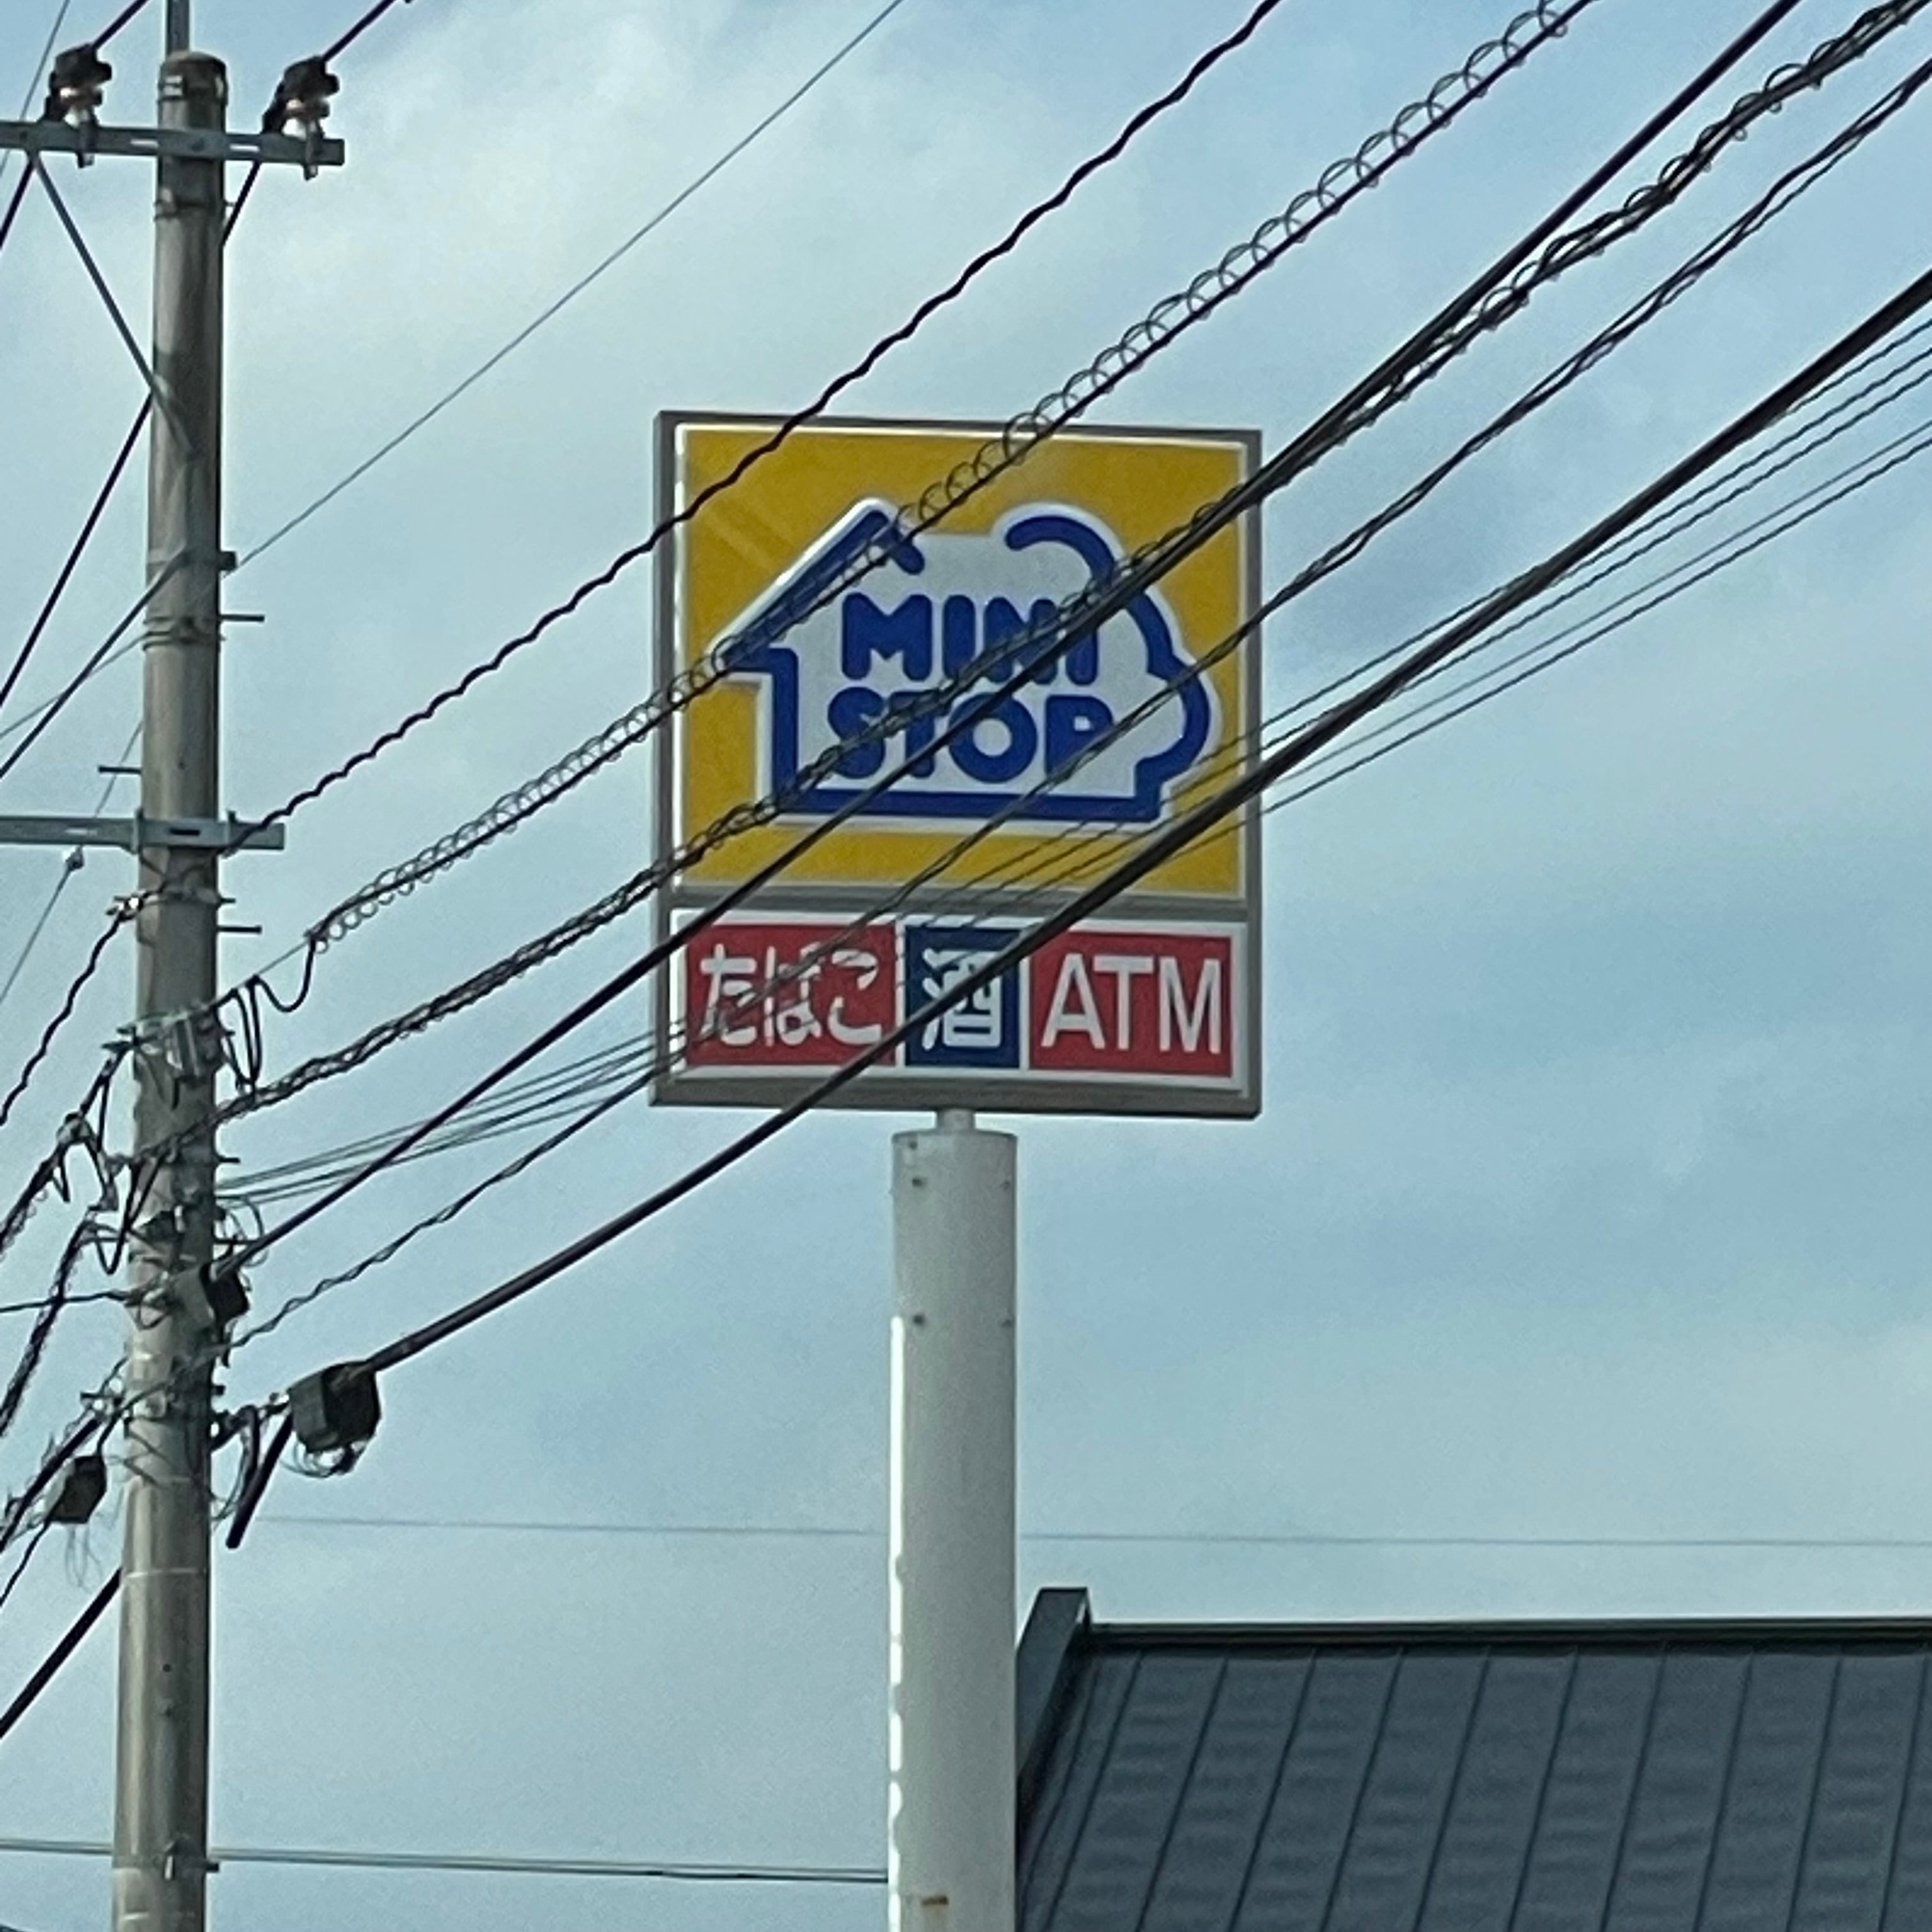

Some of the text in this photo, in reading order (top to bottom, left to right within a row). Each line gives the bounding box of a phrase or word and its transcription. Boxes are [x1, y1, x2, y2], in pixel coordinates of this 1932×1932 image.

[841, 592, 1098, 686] MINI
[827, 686, 1114, 784] STOP
[700, 941, 882, 1047] たばこ
[921, 947, 1003, 1050] 酒
[1040, 952, 1222, 1055] ATM
